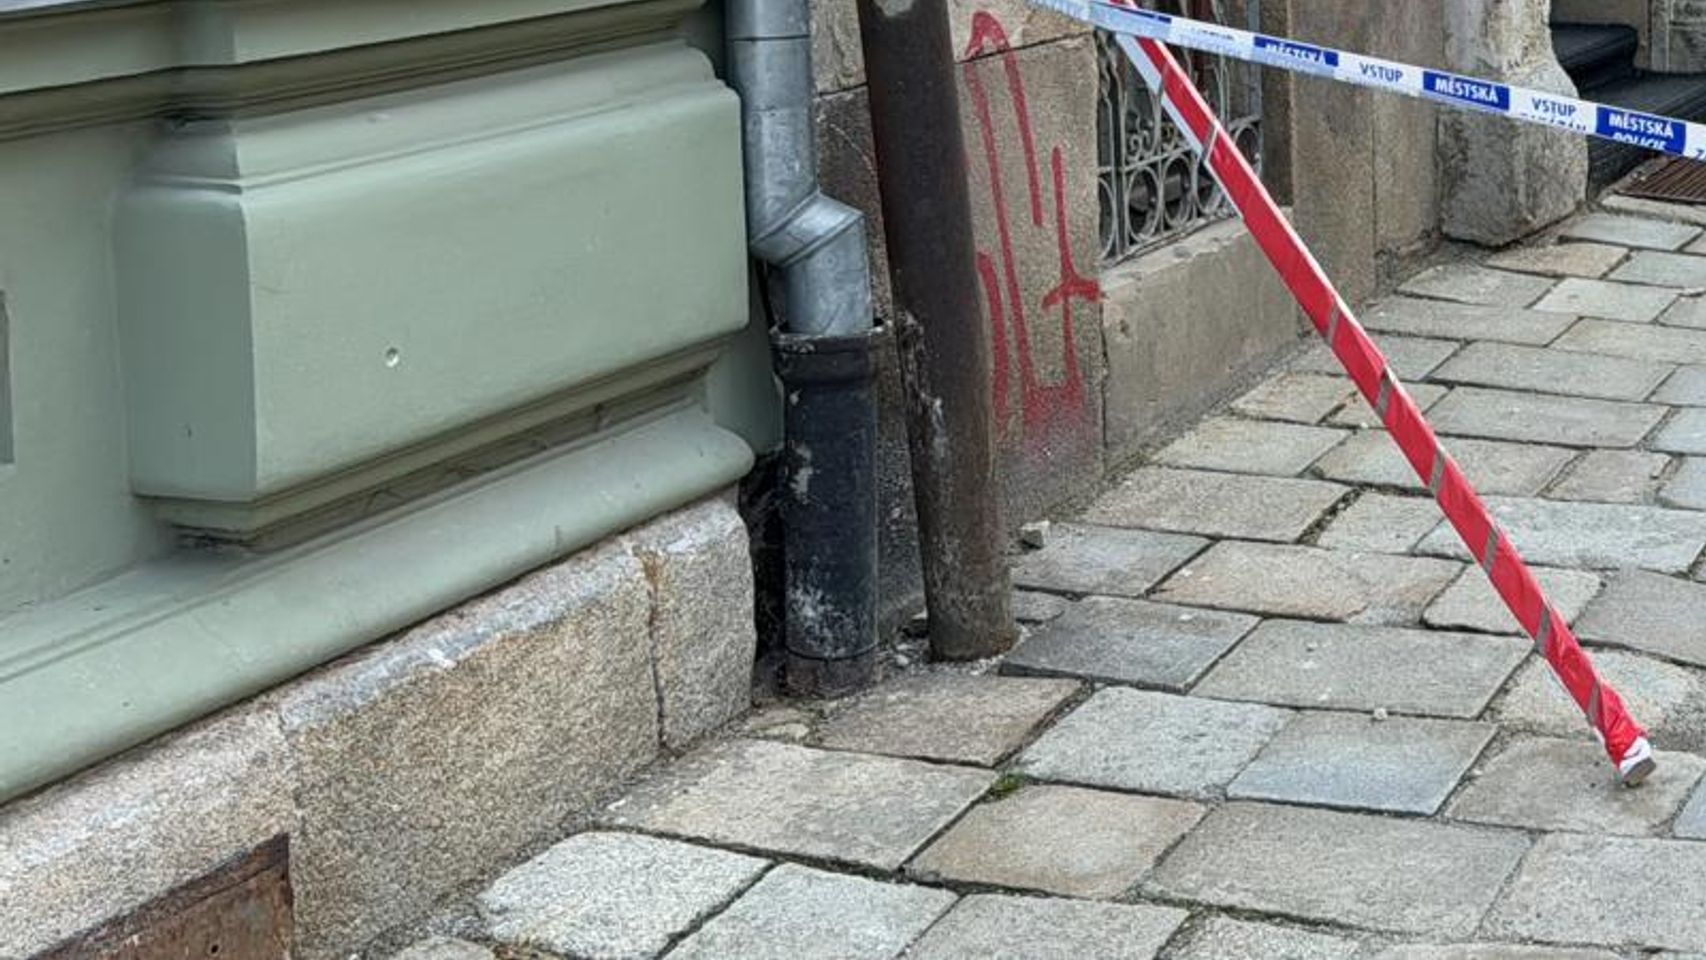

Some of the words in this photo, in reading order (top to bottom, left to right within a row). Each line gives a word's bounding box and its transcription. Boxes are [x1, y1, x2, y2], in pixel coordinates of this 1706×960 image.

[1359, 62, 1404, 83] VSTUP
[1434, 76, 1499, 104] MĚSTSKÁ
[1531, 97, 1577, 118] VSTUP
[1609, 112, 1674, 139] MĚSTSKÁ
